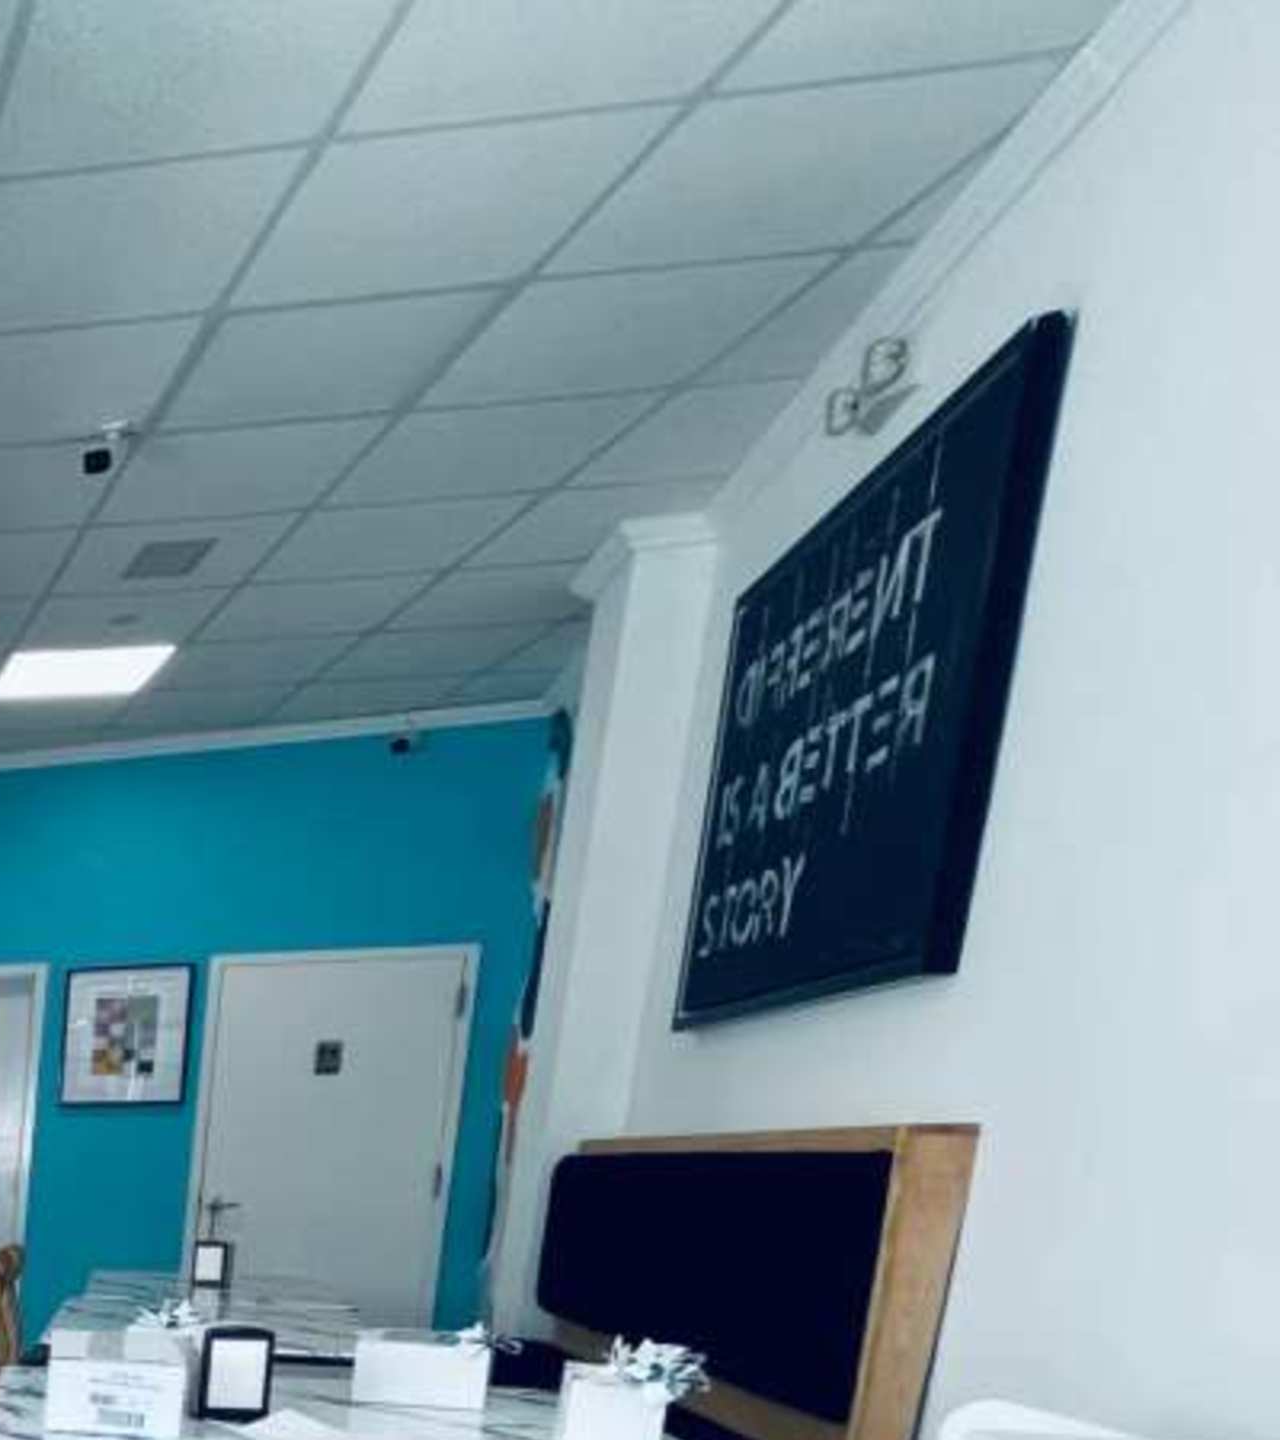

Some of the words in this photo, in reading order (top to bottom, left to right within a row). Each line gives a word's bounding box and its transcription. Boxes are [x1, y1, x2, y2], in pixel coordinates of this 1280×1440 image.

[716, 775, 744, 848] IS
[745, 762, 771, 831] A
[774, 652, 936, 821] BETTER
[697, 853, 807, 958] STORY
